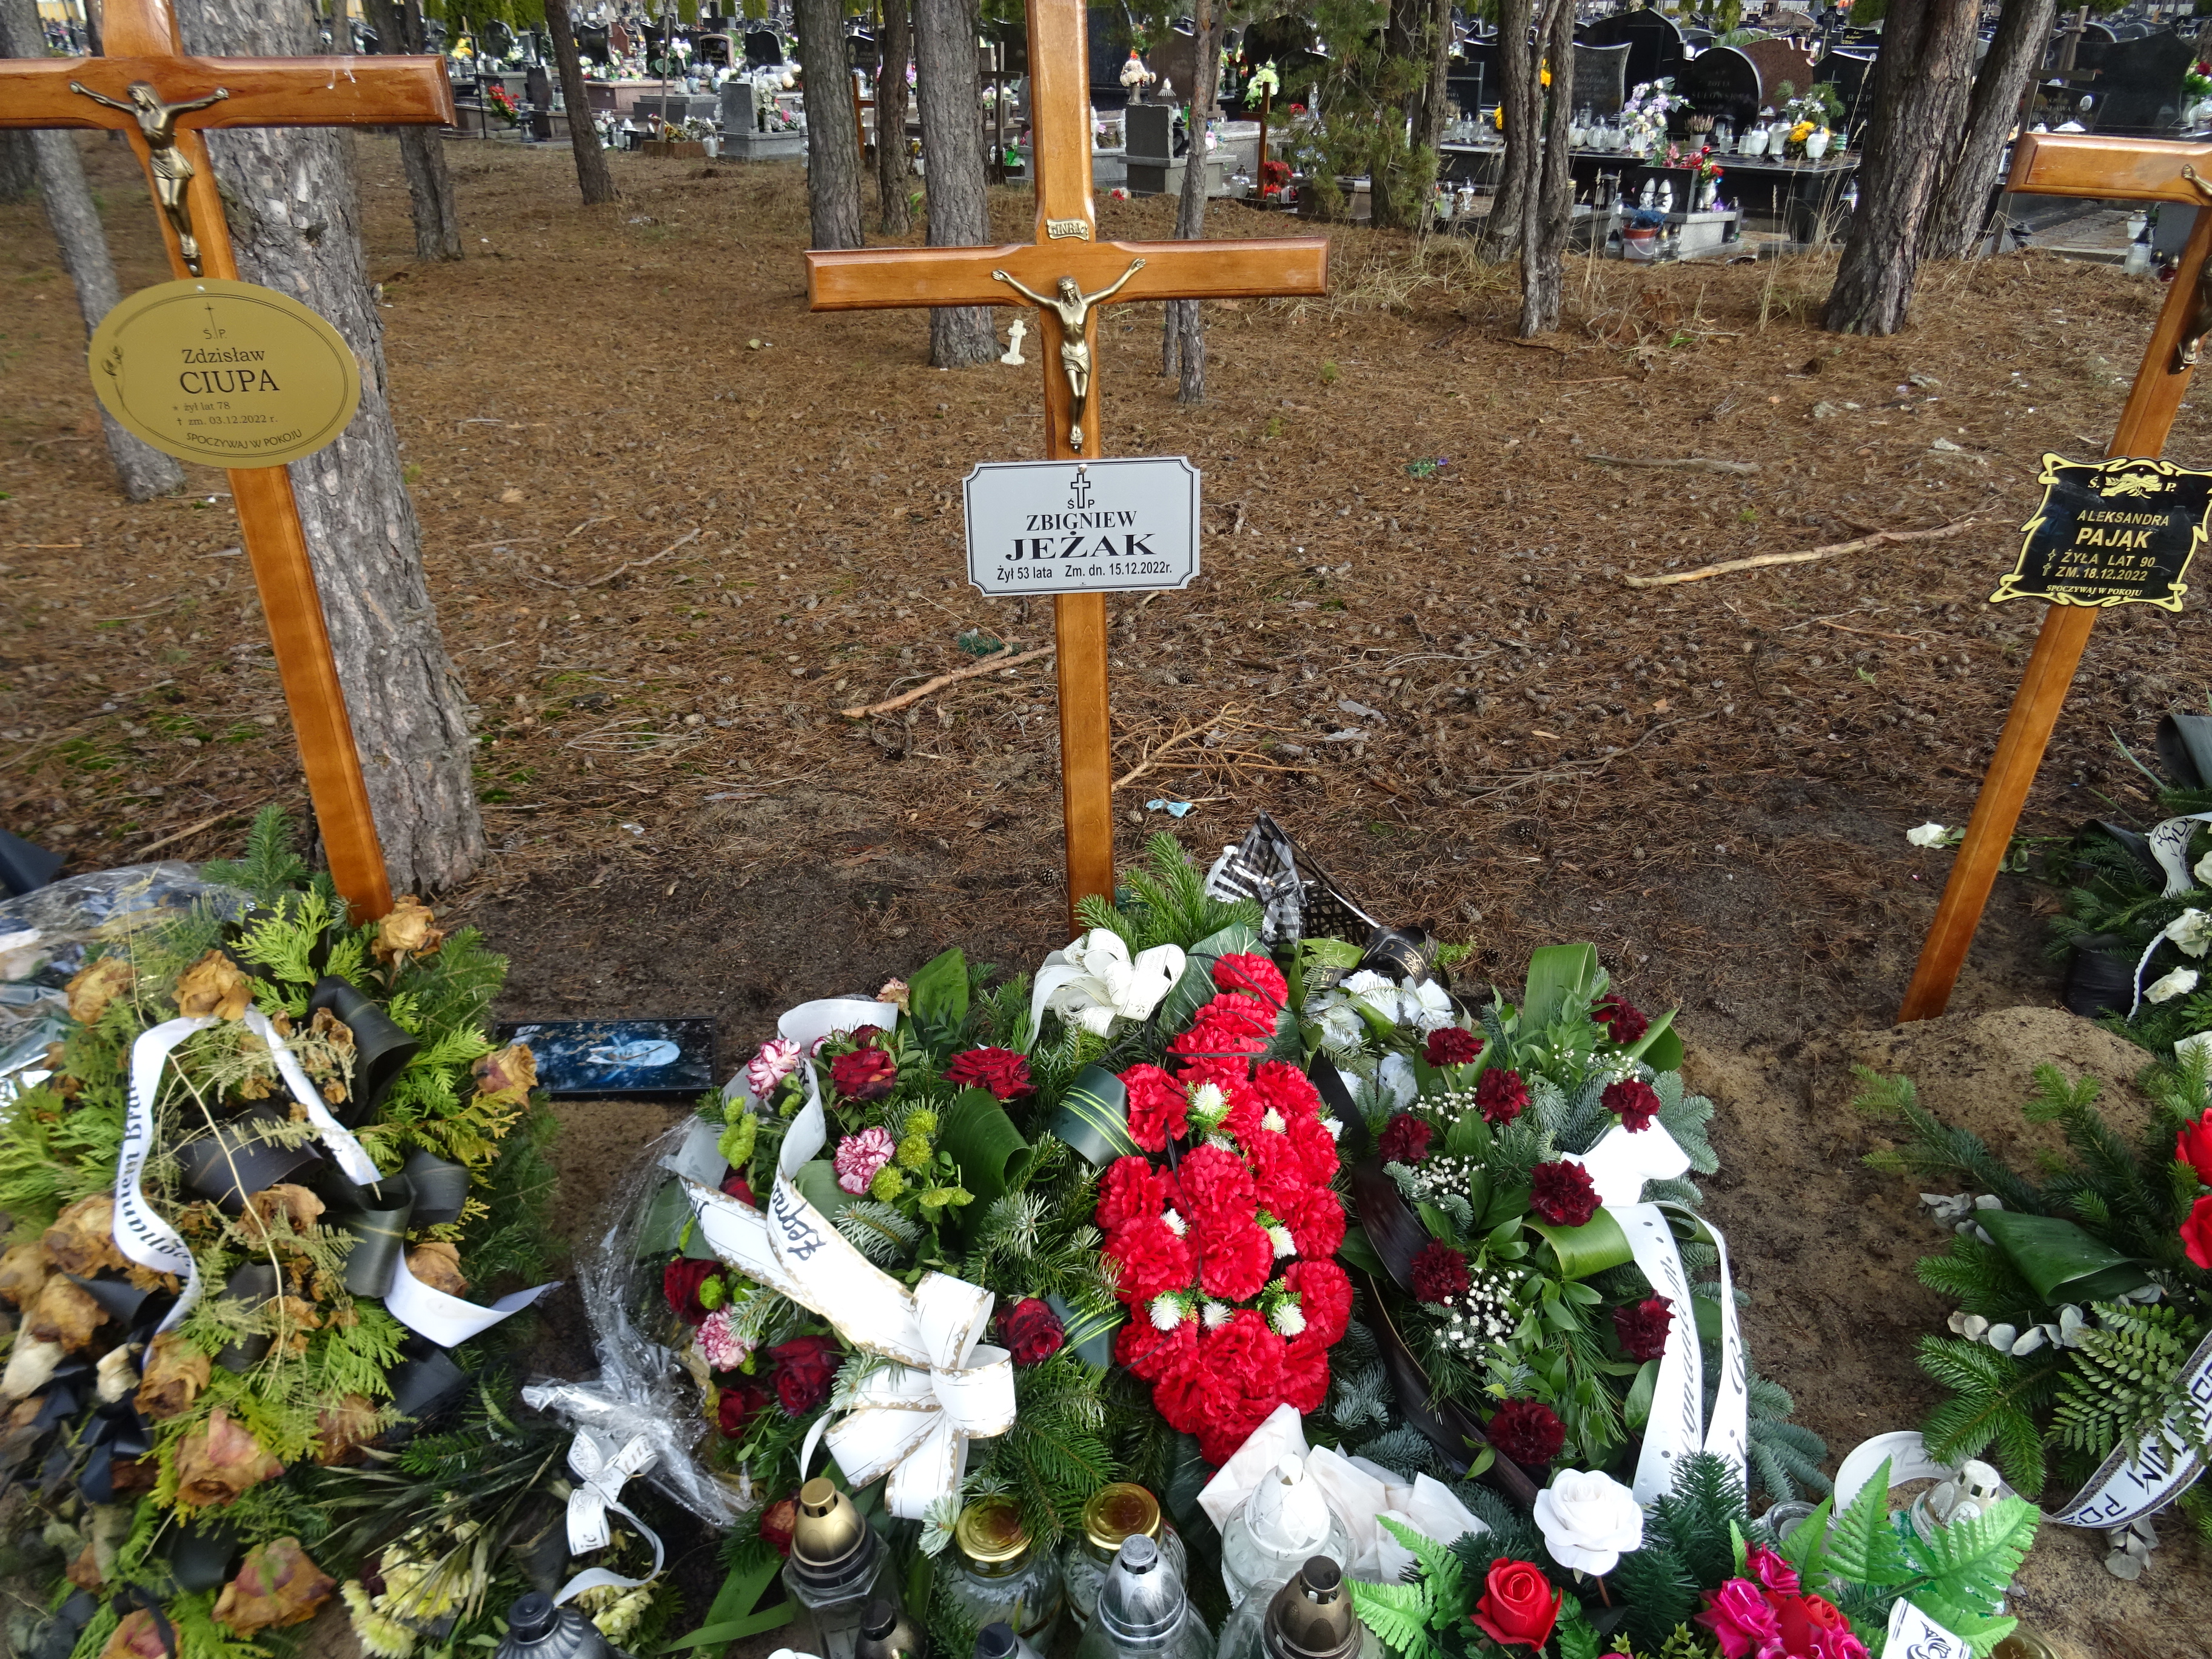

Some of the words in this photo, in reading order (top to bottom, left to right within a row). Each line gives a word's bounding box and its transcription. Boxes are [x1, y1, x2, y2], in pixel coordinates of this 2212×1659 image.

[1056, 223, 1081, 235] INRI
[182, 347, 265, 363] Zdzisław
[179, 369, 280, 394] CIUPA
[184, 403, 199, 414] żył
[200, 402, 215, 411] lat
[217, 401, 230, 411] 78
[188, 417, 206, 426] zm.
[209, 415, 267, 425] 03.12.2022
[186, 432, 248, 449] SPOCZYWAJ
[250, 439, 261, 449] W
[263, 429, 303, 447] POKOJU
[1067, 498, 1074, 509] Ś
[1088, 500, 1095, 508] P
[1026, 511, 1138, 531] ZBIGNIEW
[2076, 509, 2170, 527] ALEKSANDRA
[1005, 531, 1157, 561] JEŻAK
[2075, 528, 2153, 552] PAJĄK
[2061, 549, 2099, 565] ŻYŁA
[2107, 554, 2136, 566] LAT
[2139, 557, 2156, 568] 90
[997, 565, 1014, 583] Żył
[1017, 567, 1029, 580] 53
[1033, 566, 1053, 578] lata
[1065, 565, 1085, 577] Zm.
[1089, 563, 1105, 577] dn.
[1109, 561, 1172, 575] 15.12.2022r.
[2054, 566, 2079, 578] ZM.
[2083, 568, 2148, 581] 18.12.2022
[2045, 585, 2097, 595] SPOCZYWAJ
[2106, 588, 2143, 597] POKOJU
